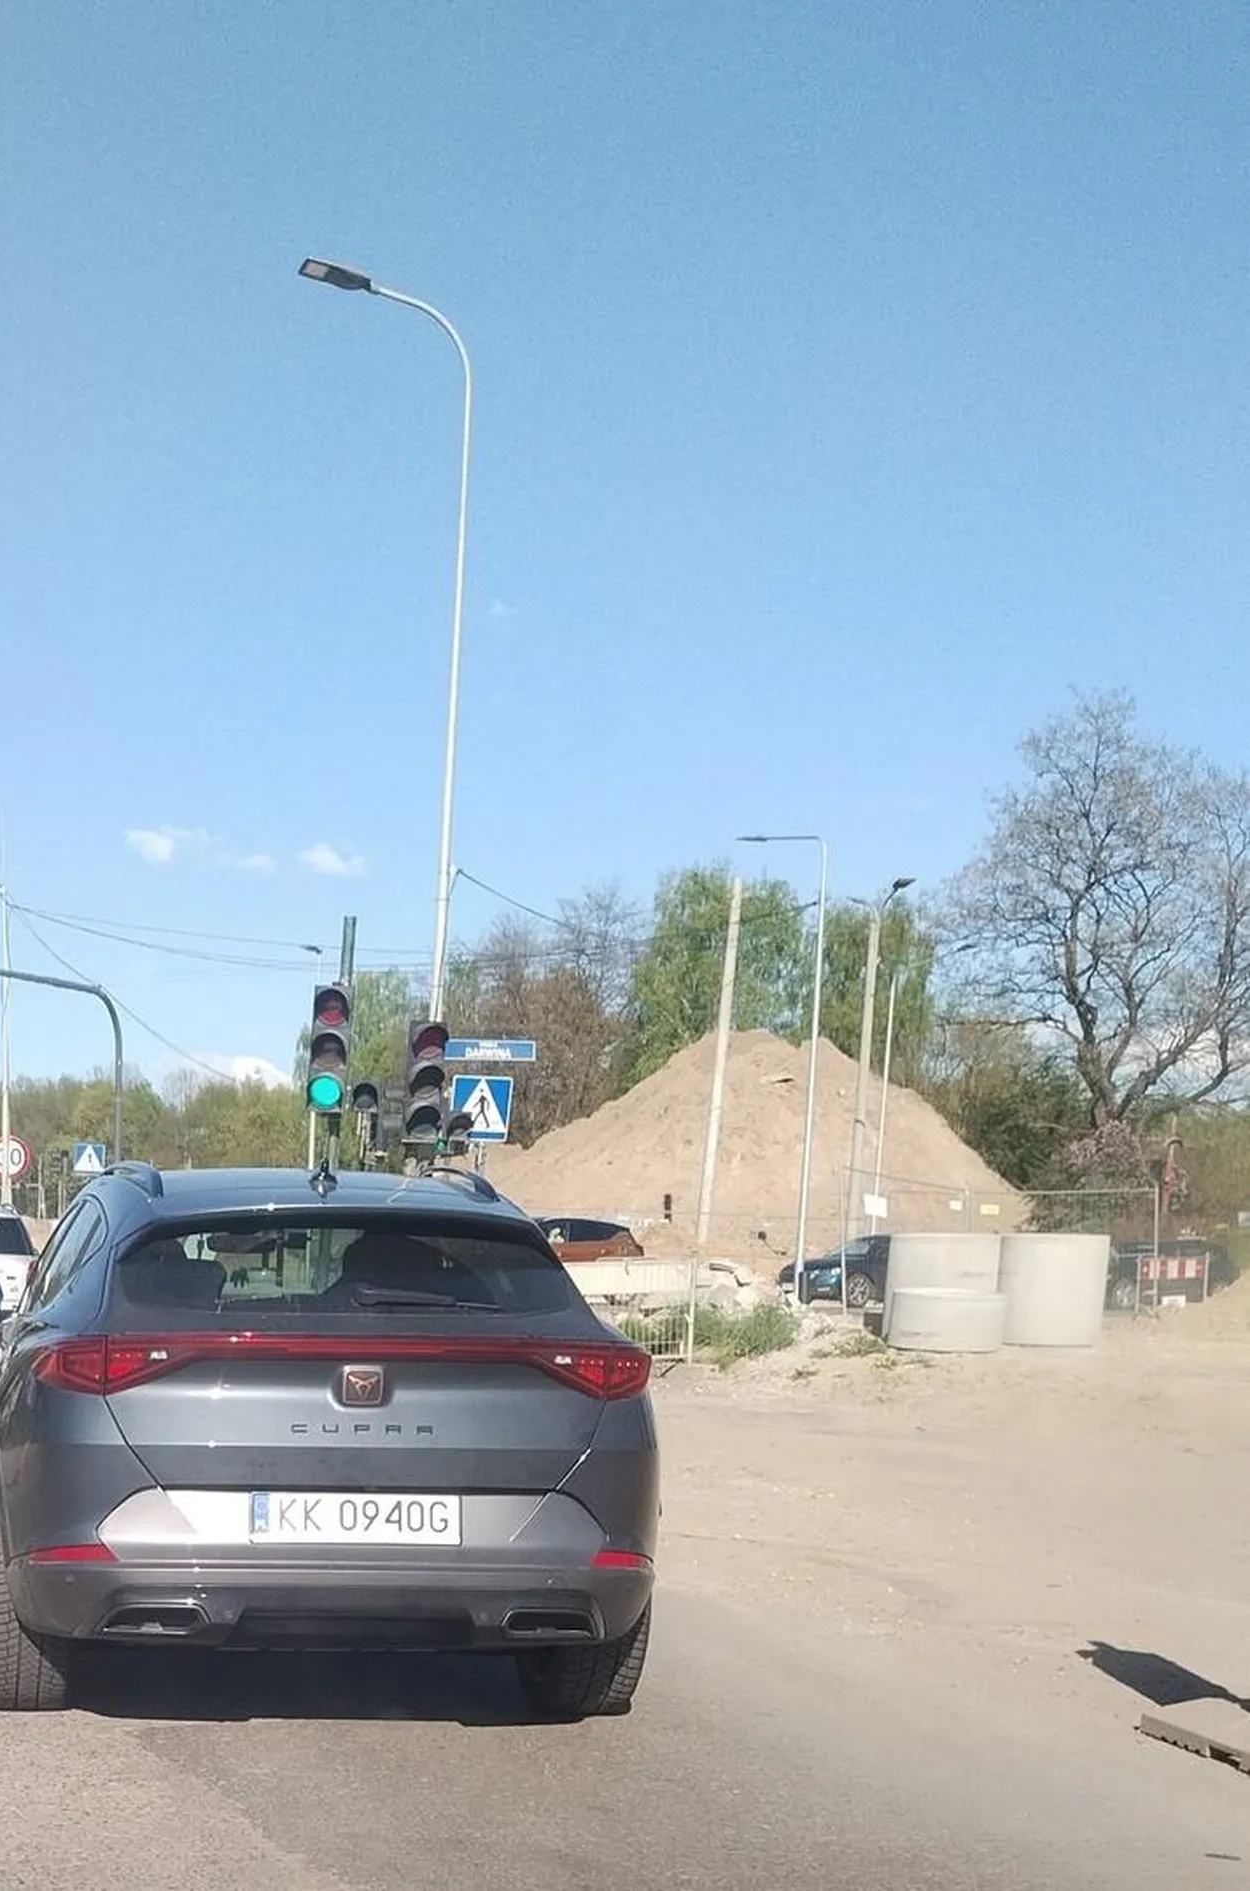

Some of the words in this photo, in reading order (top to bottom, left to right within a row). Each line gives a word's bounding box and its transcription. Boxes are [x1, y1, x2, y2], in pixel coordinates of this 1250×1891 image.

[290, 1423, 434, 1436] CUPRA
[278, 1498, 322, 1532] KK
[339, 1499, 449, 1533] 0940G
